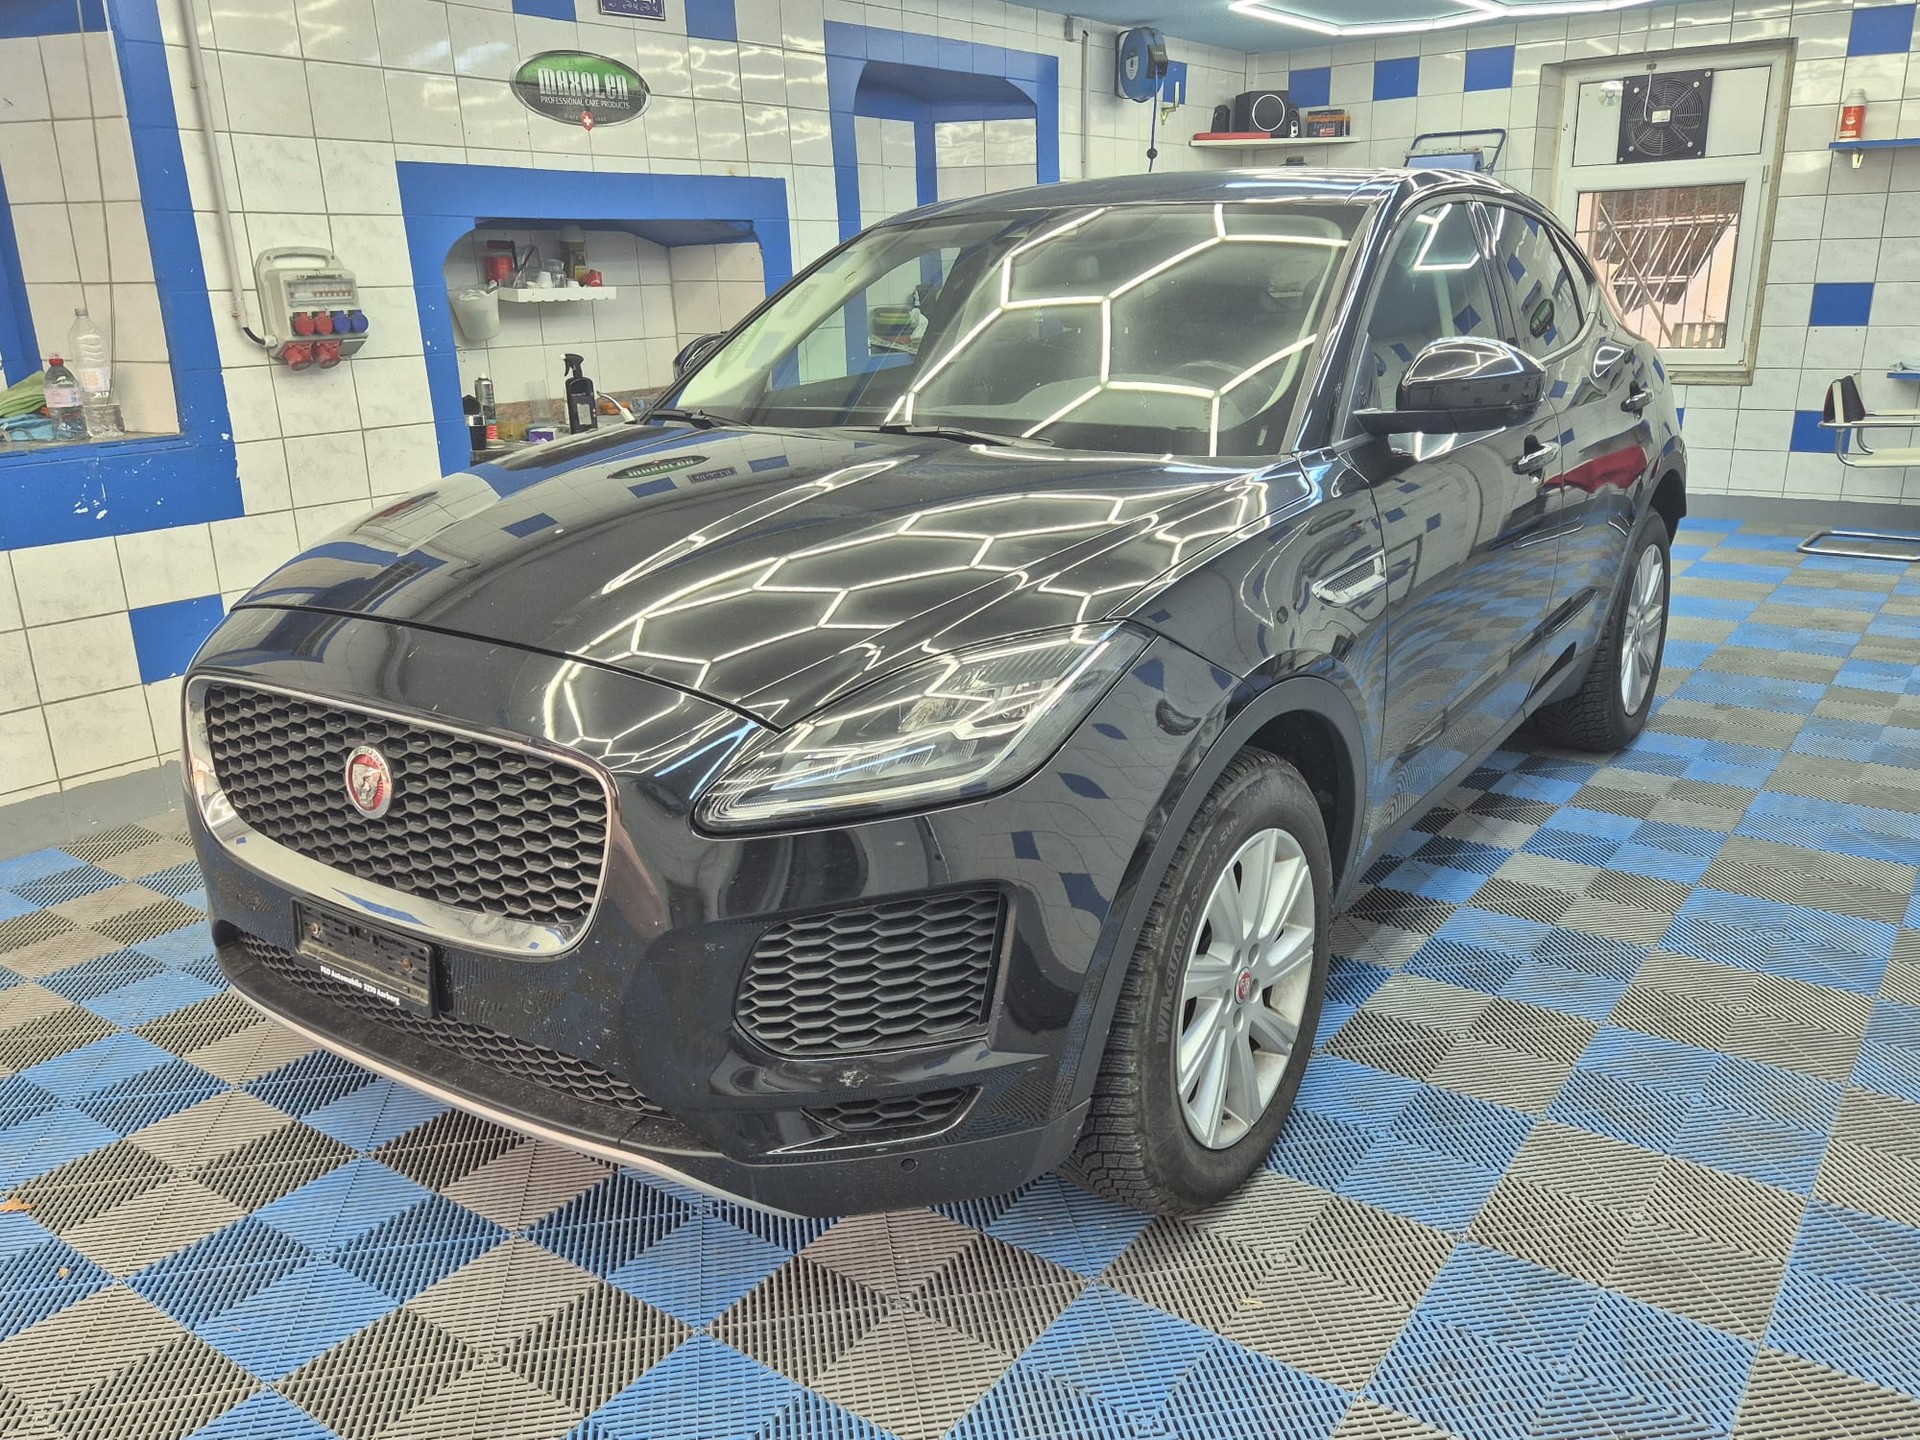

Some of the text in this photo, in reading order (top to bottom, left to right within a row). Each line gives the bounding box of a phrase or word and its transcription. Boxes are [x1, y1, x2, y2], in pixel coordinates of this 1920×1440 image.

[540, 95, 584, 107] PROFESSIONAL
[600, 100, 631, 110] PRODUCTS
[1156, 903, 1192, 1044] WINGUARD
[1220, 814, 1239, 846] SUV
